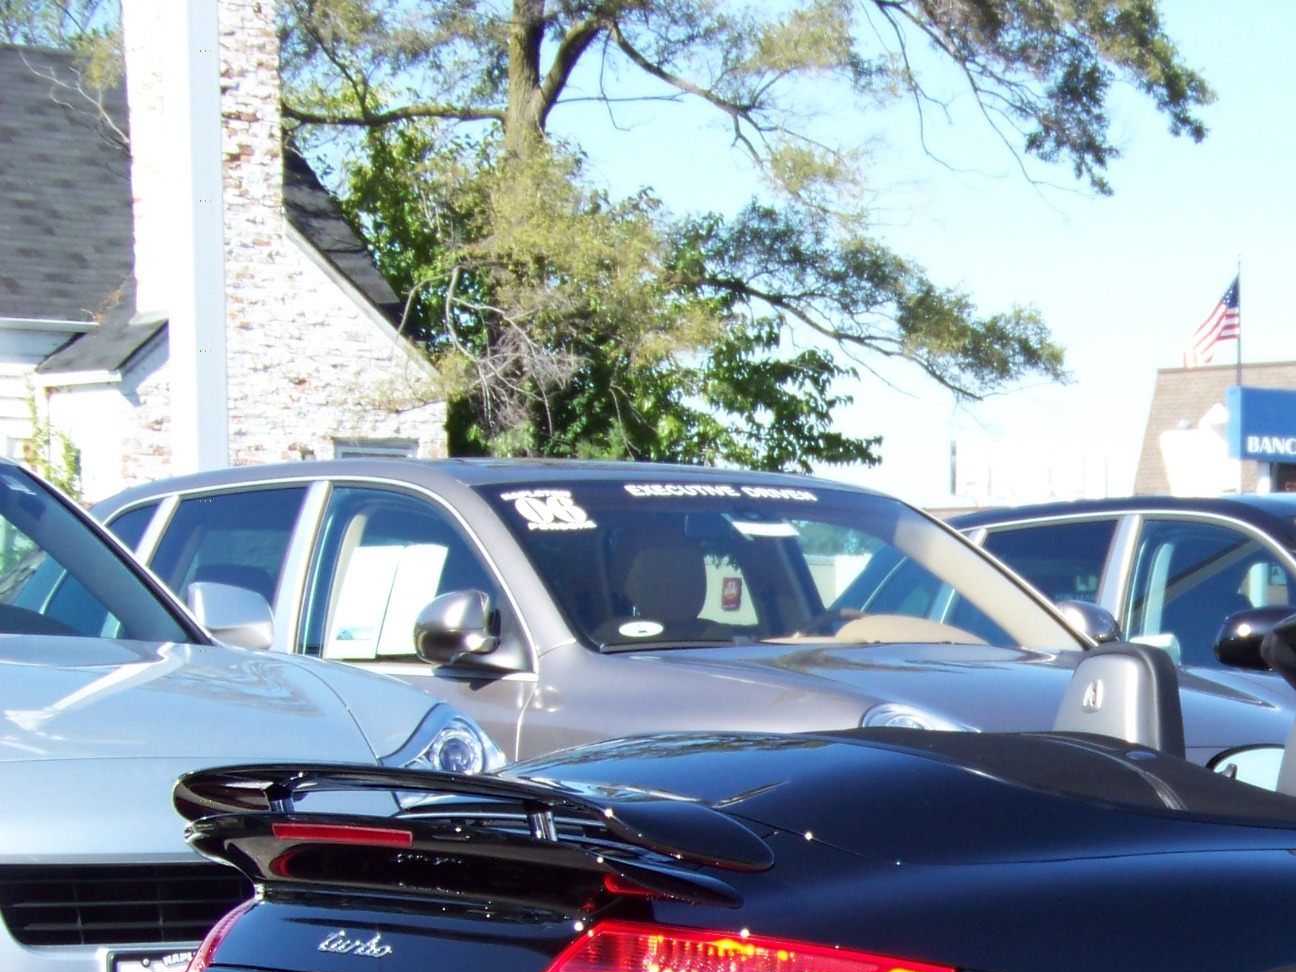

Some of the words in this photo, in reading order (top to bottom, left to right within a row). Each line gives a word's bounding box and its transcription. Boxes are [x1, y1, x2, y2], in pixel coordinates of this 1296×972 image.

[624, 484, 741, 497] EXECUTIVE
[740, 486, 819, 502] DRIVEN
[317, 929, 394, 958] turbo
[162, 951, 197, 967] NAPL
